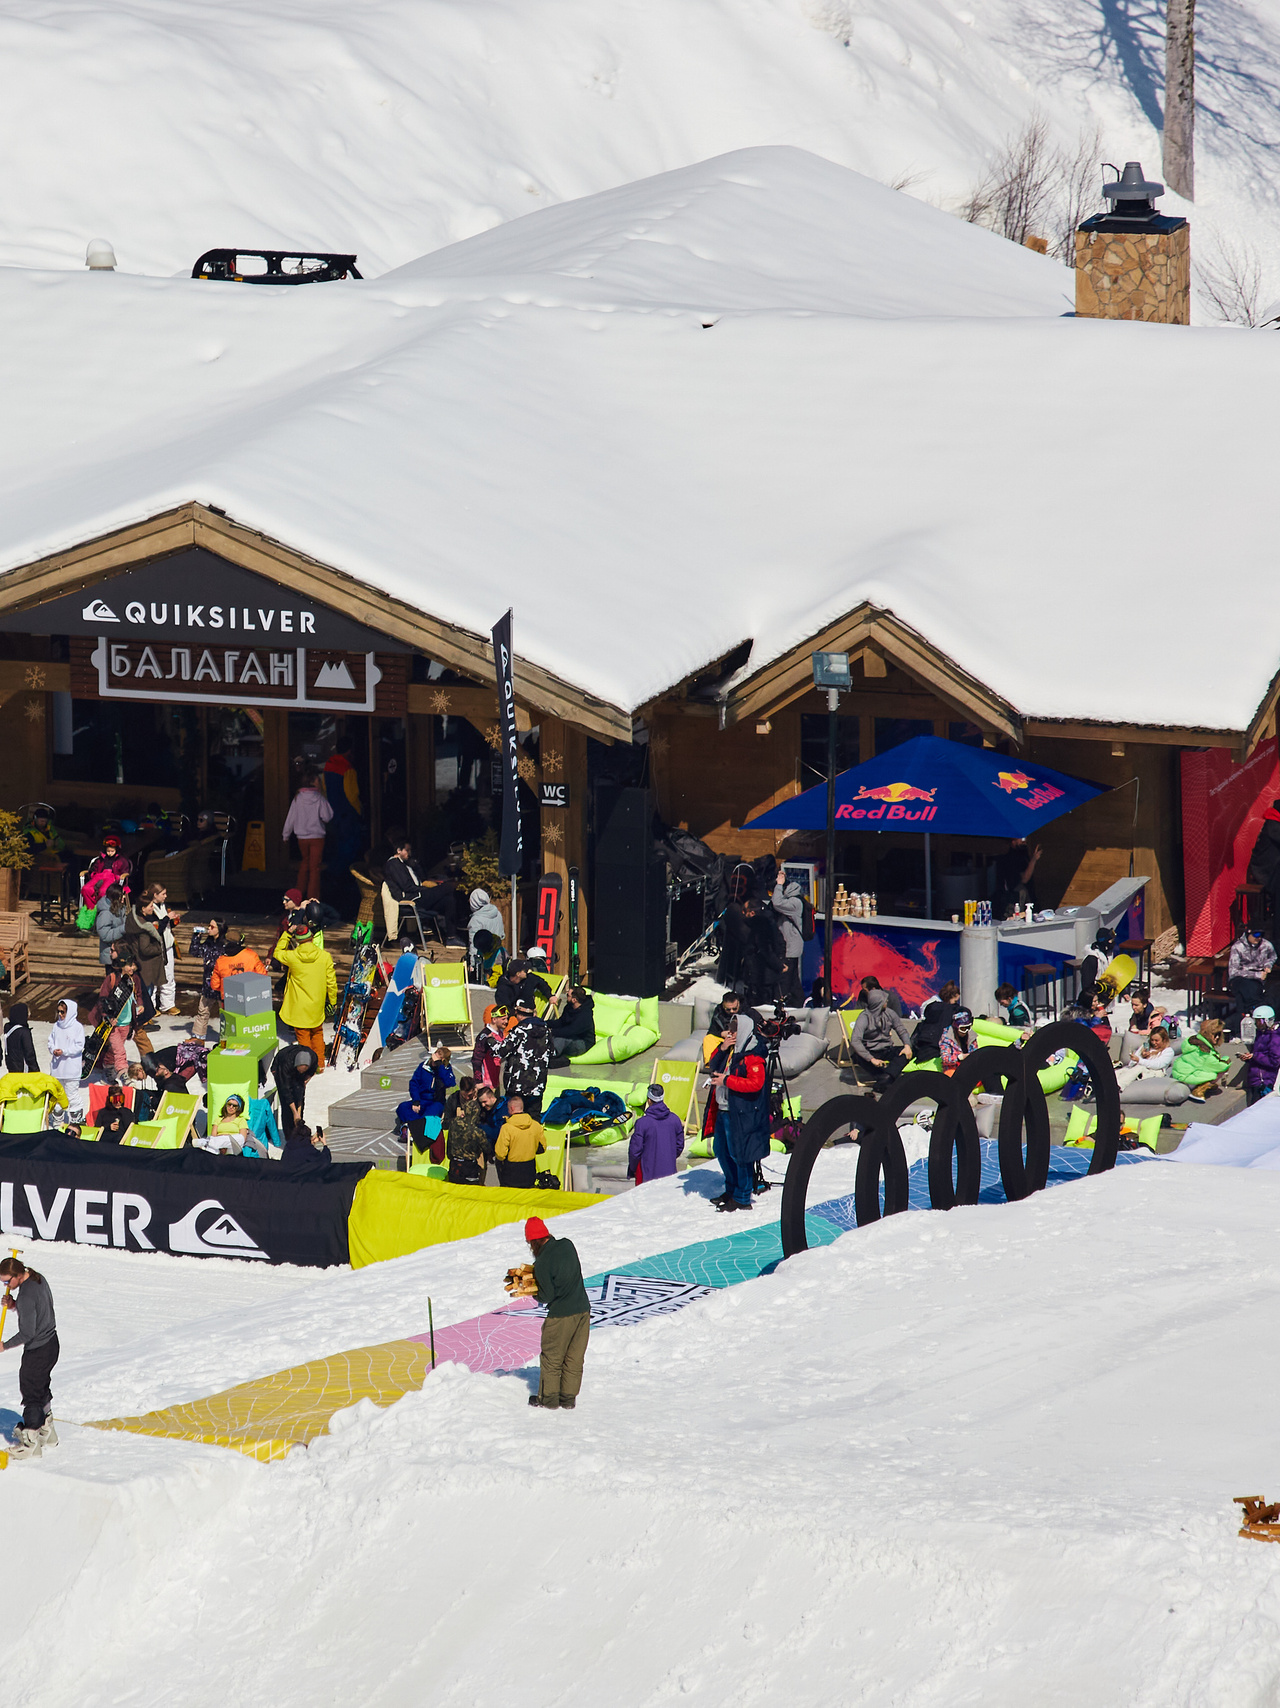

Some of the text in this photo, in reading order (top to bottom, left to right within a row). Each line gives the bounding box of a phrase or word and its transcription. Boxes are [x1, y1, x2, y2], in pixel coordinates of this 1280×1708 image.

[125, 601, 316, 634] QUIKSILVER
[110, 644, 294, 687] БАЛАГАН
[544, 784, 566, 800] WC
[1015, 782, 1066, 810] Red Bull
[834, 804, 938, 821] Red Bull
[243, 1023, 270, 1034] FLIGHT
[381, 1078, 390, 1087] S7
